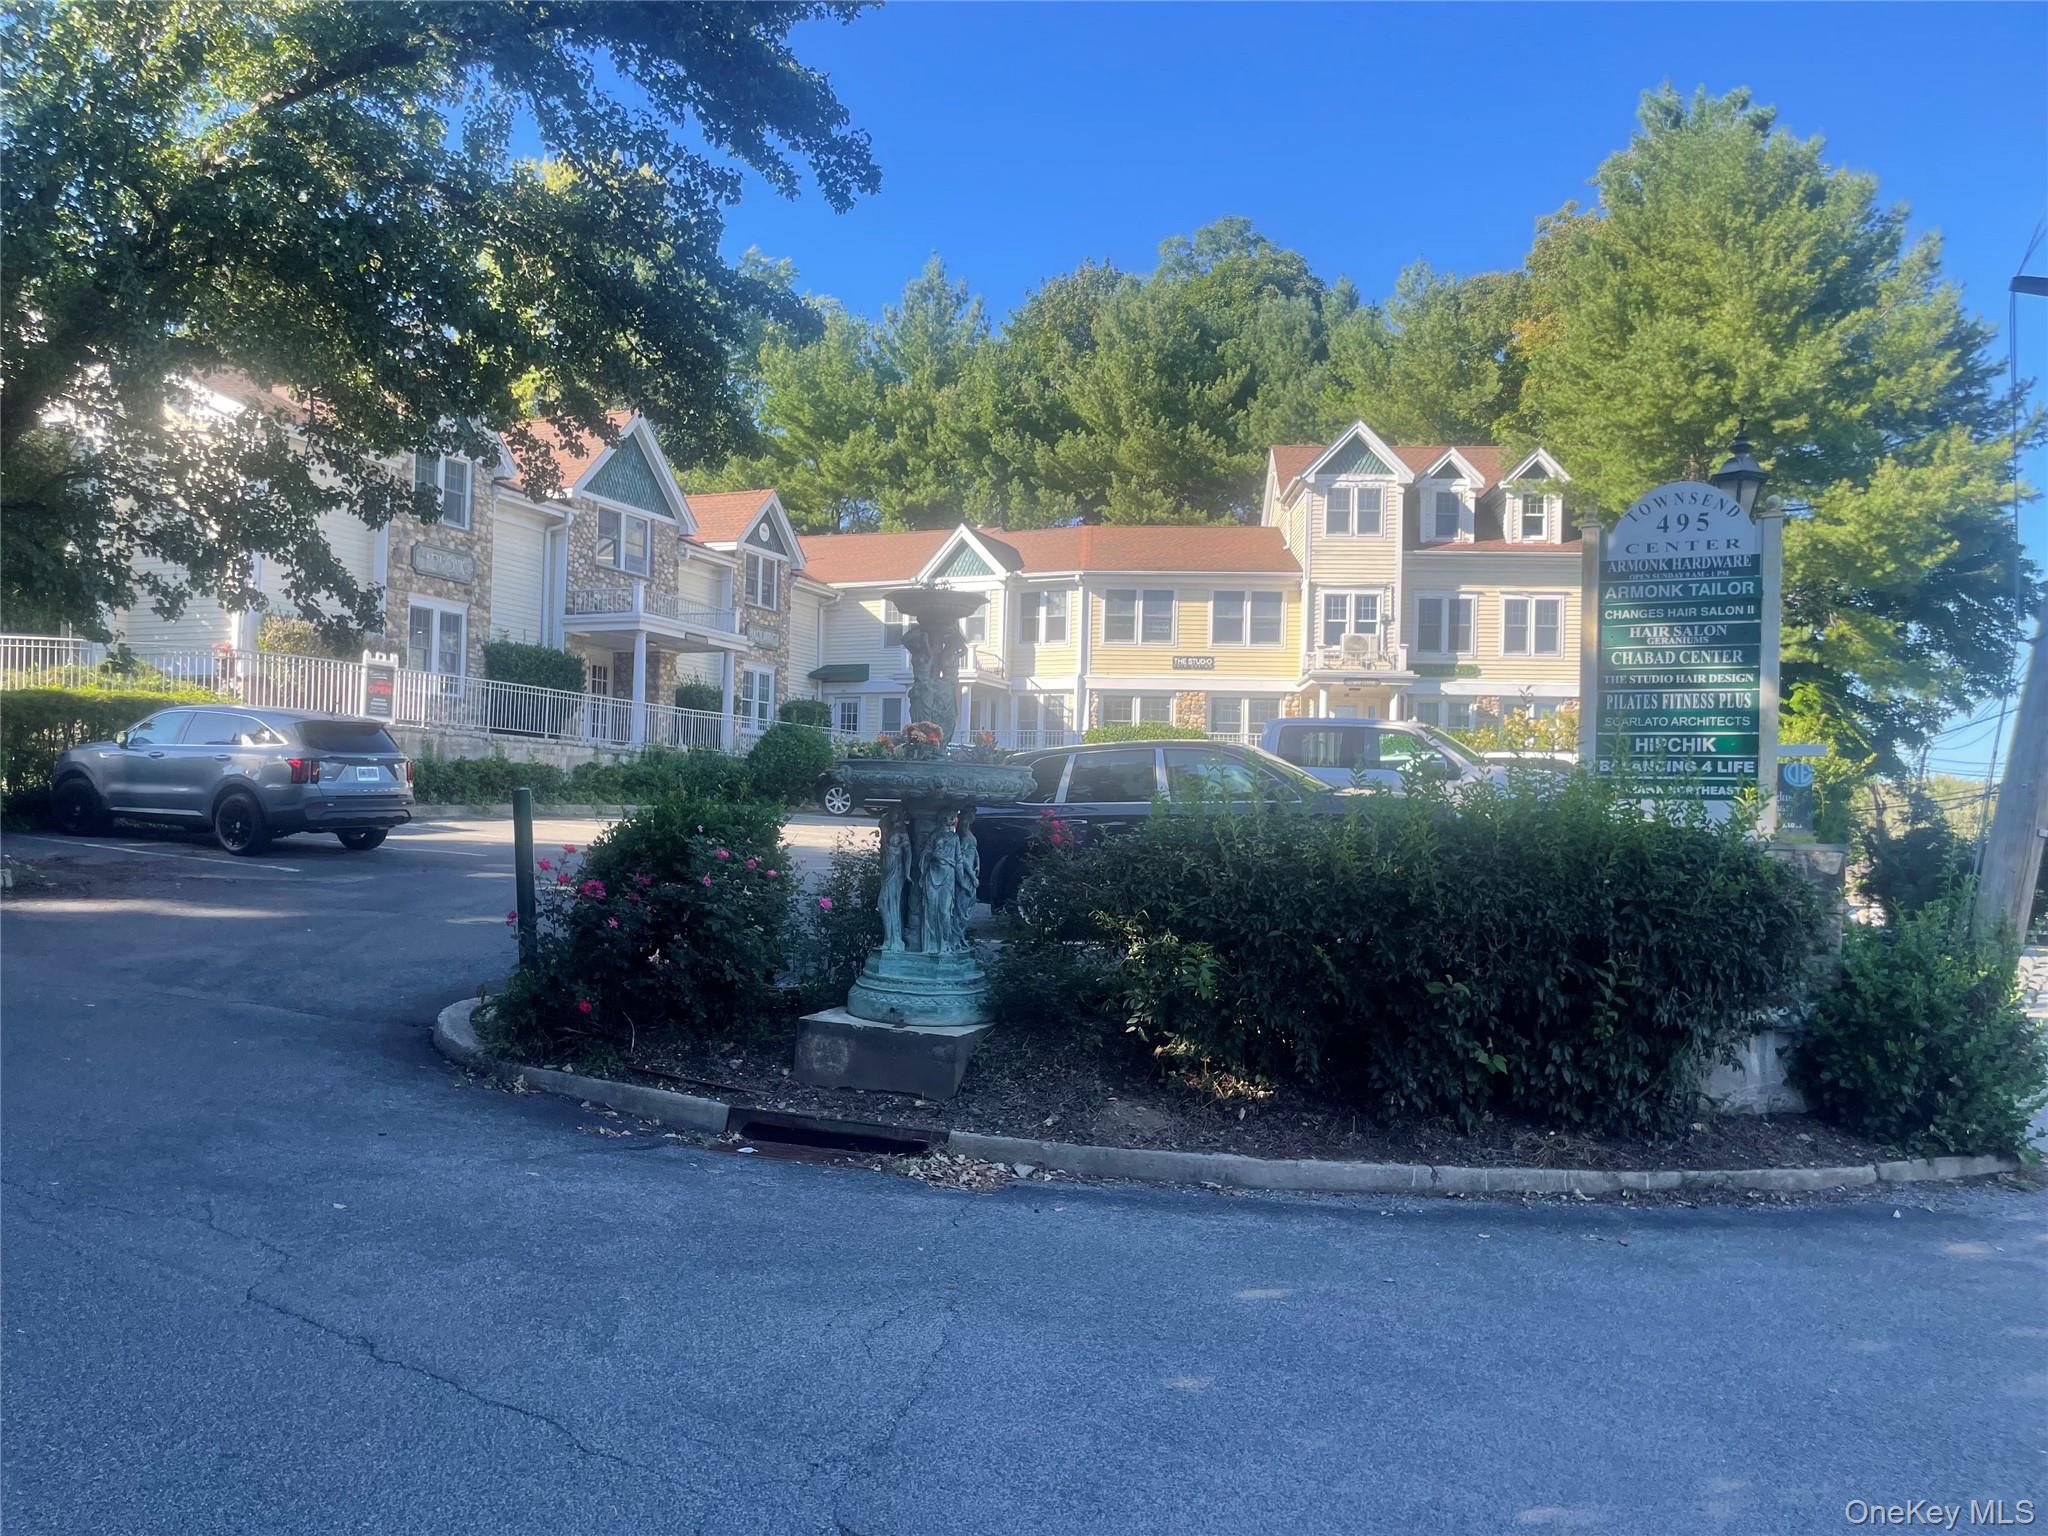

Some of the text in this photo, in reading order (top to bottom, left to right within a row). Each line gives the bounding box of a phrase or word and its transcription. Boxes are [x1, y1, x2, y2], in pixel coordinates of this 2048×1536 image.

[1625, 491, 1741, 524] TOWNSEND
[1656, 512, 1710, 533] 495
[1625, 538, 1742, 554] CENTER
[1607, 555, 1752, 573] ARMONK HARDWARE
[1604, 581, 1755, 599] ARMONK TAILOR
[1604, 608, 1664, 620] CHANGES
[1667, 607, 1697, 618] HAIR
[1700, 606, 1744, 617] SALON
[1629, 624, 1728, 638] HAIR SALON
[1646, 636, 1710, 645] GERANIUMS
[1611, 649, 1743, 665] CHABAD CENTER
[1604, 673, 1754, 684] THE STUDIO HAIR DESIGN
[1606, 692, 1752, 710] PILATES FITNESS PLUS
[1604, 716, 1751, 727] SCARLATO ARCHITECTS
[1701, 761, 1713, 773] 4
[1717, 760, 1755, 773] LIFE
